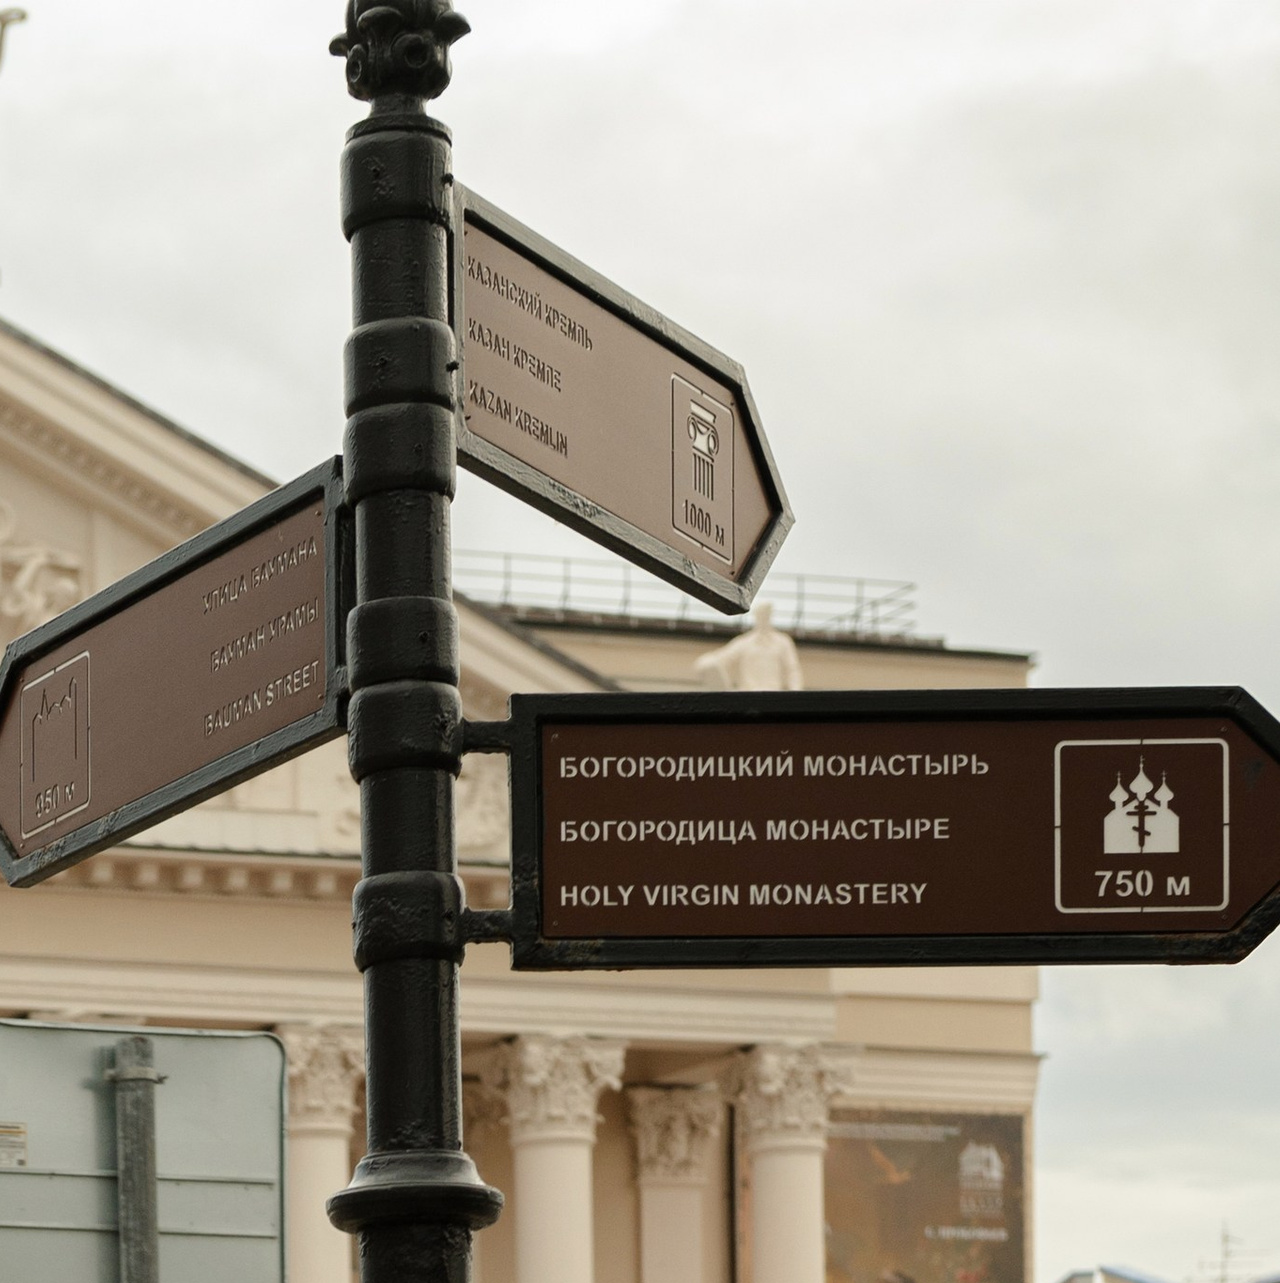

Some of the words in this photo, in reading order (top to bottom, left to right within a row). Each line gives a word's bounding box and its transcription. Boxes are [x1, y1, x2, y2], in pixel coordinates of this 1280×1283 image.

[467, 255, 542, 320] КАЗАНСКИЙ
[545, 303, 593, 351] КРЕМЛЬ
[468, 317, 510, 361] КАЗАН
[513, 344, 562, 393] КРЕМЛЕ
[469, 379, 512, 424] KAZAN
[515, 406, 568, 458] KREMLIN
[682, 499, 712, 538] 1000
[202, 574, 248, 615] УЛИЦА
[250, 535, 318, 589] БАУМАНА
[210, 624, 266, 673] БАУМАН
[268, 595, 320, 643] УРАМЫ
[204, 688, 262, 737] BAUMAN
[265, 658, 320, 707] STREET
[560, 750, 794, 782] БОГОРОДИЦКИЙ
[803, 753, 990, 777] МОНАСТЫРЬ
[560, 820, 757, 846] БОГОРОДИЦА
[766, 818, 951, 841] МОНАСТЫРЕ
[560, 885, 635, 907] HOLY
[642, 884, 739, 906] VIRGIN
[749, 883, 928, 905] MONASTERY
[1094, 870, 1155, 897] 750
